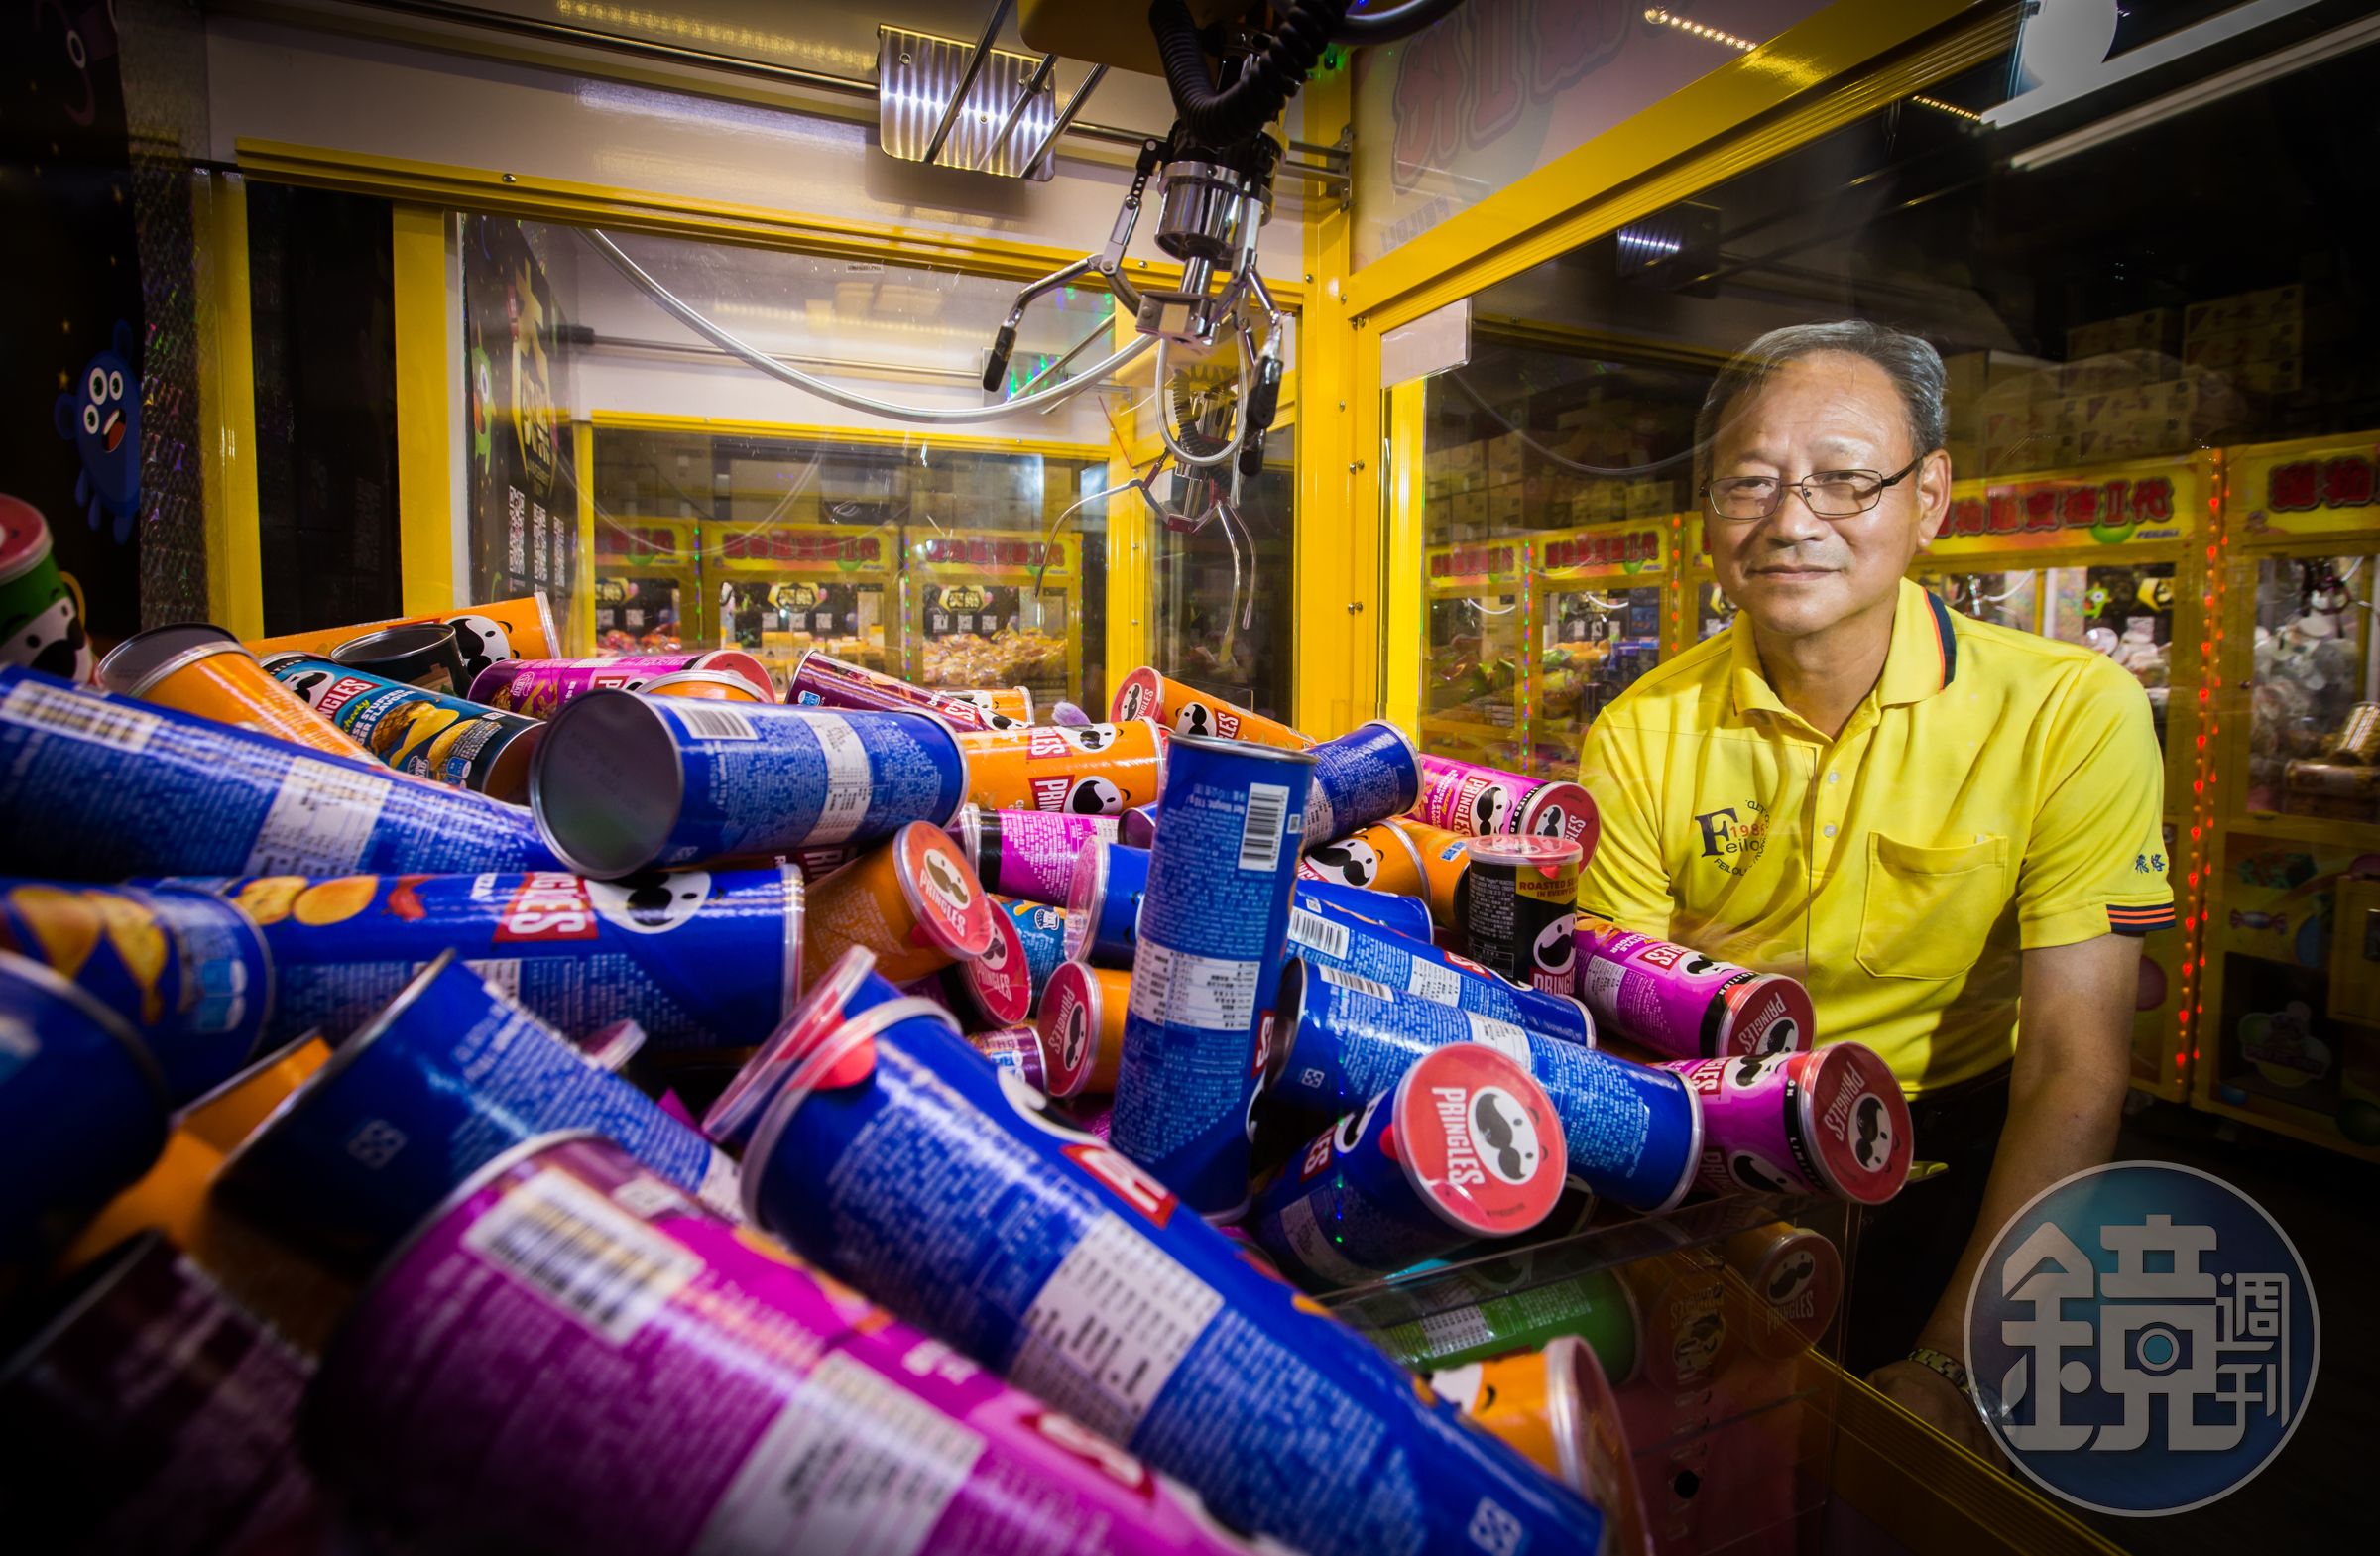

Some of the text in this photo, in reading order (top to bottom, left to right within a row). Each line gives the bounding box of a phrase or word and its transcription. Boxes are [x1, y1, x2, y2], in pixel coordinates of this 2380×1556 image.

[1452, 778, 1488, 836] PRINGLES
[919, 867, 968, 938] PRINGLES
[1519, 881, 1566, 891] ROASTED
[975, 960, 1012, 1002] PRINGLES
[1048, 984, 1075, 1055] PRINGLES
[1737, 992, 1787, 1054] PRINGLES
[1823, 1061, 1866, 1143] PRINGLES
[1431, 1086, 1488, 1187] PRINGLES
[1766, 1289, 1815, 1336] PRINGLES
